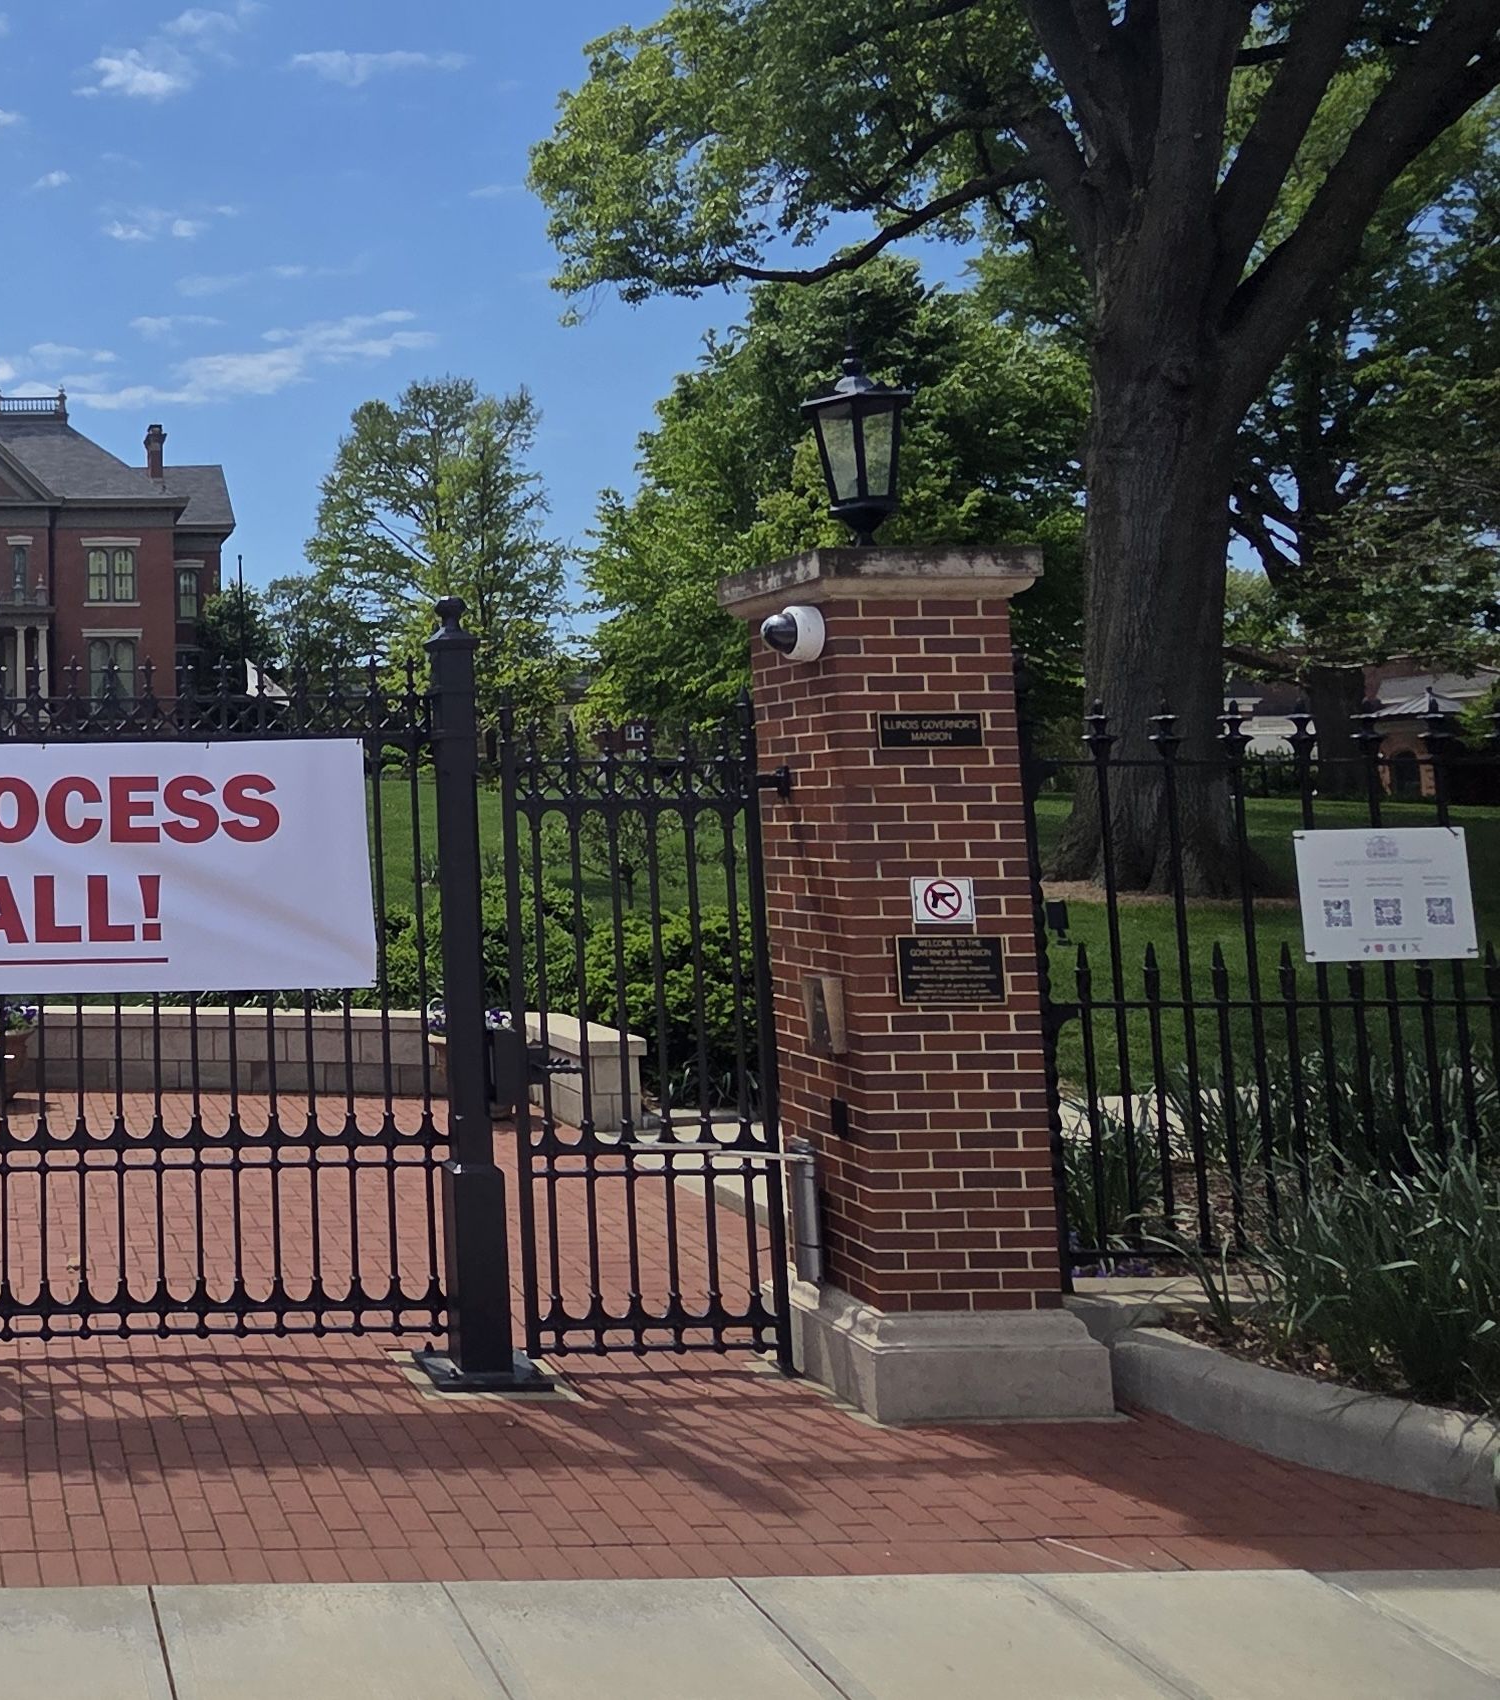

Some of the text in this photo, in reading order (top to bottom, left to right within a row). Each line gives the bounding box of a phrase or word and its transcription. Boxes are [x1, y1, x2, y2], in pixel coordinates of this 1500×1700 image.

[883, 719, 978, 729] ILLINOIS GOVERNOR'S
[911, 732, 952, 741] MANSION
[910, 948, 991, 956] GOVERNOR'S MANSION
